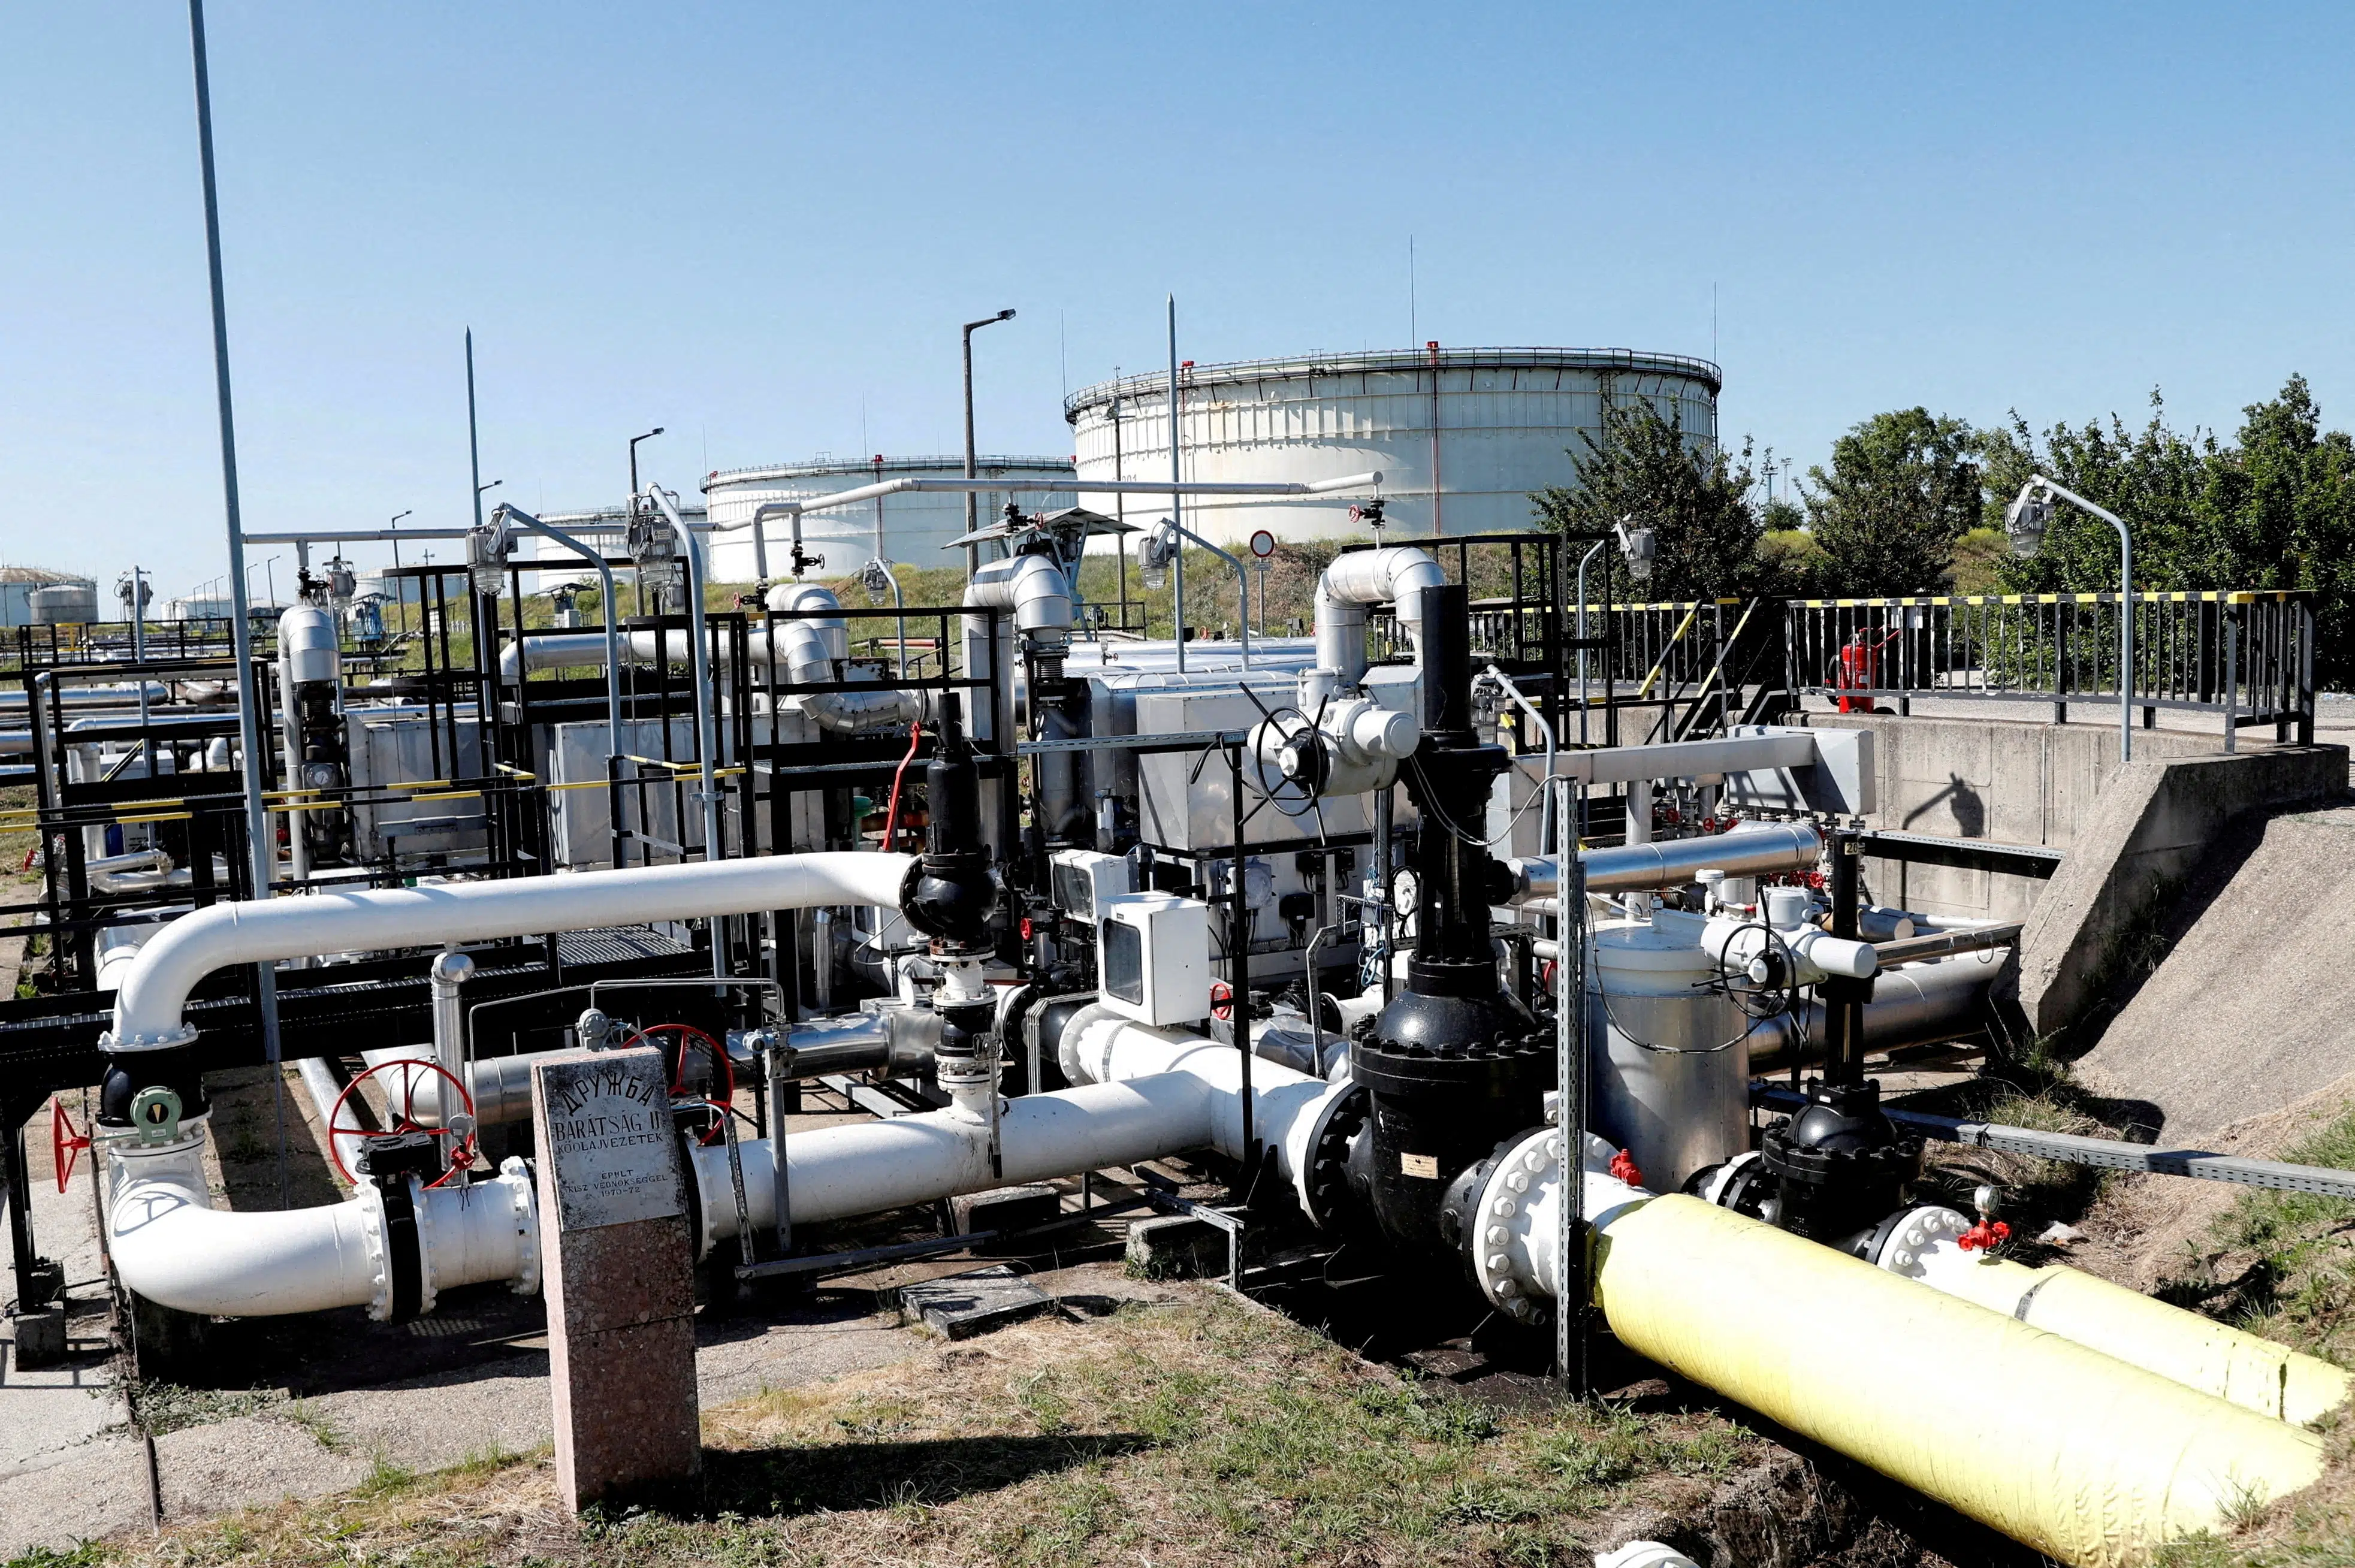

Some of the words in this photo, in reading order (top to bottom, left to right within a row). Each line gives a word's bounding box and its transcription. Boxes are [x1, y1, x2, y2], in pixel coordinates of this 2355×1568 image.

[561, 1072, 656, 1117] ДРУЖБА
[555, 1110, 642, 1141] BARÁTSÁG
[601, 1187, 641, 1197] 1970-72
